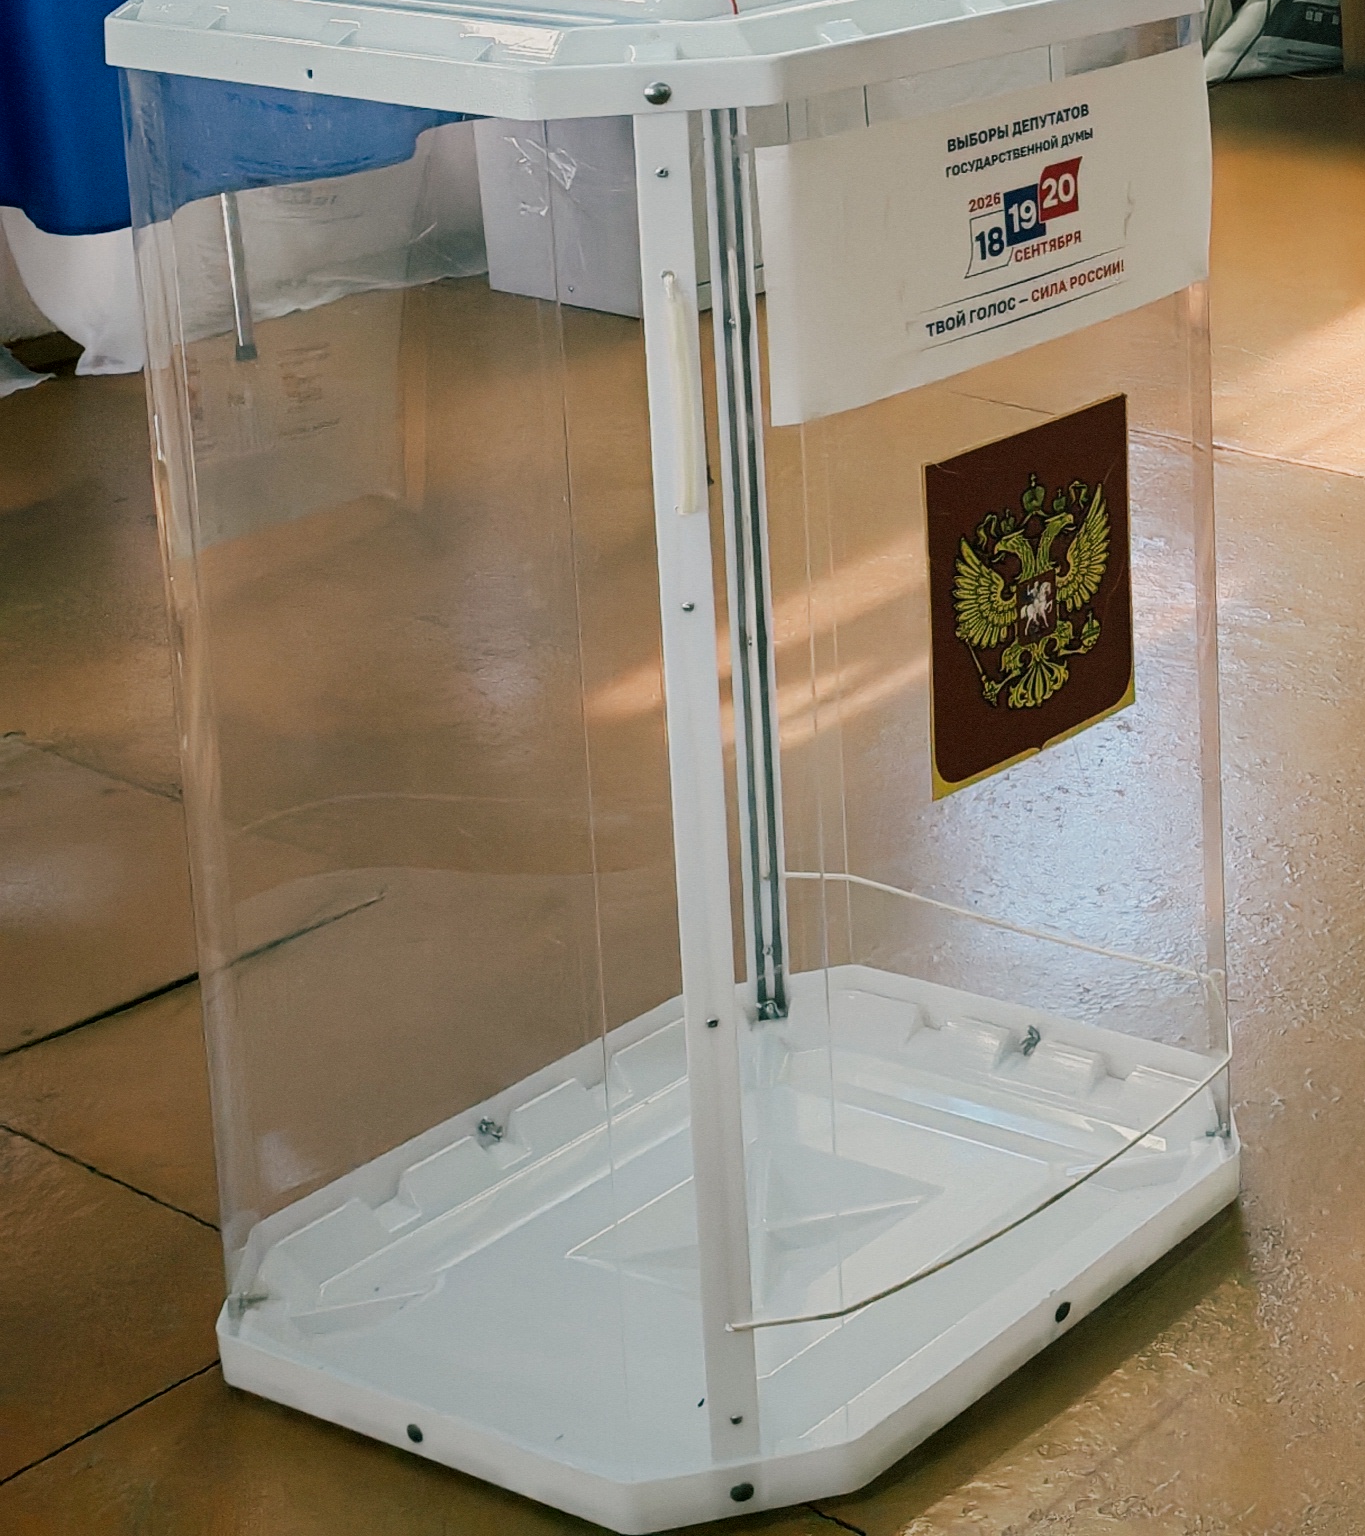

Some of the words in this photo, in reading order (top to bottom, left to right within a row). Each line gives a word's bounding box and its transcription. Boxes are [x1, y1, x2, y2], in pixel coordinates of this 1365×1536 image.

[945, 135, 1058, 178] ГОСУДАРСТВЕННОЙ
[1061, 128, 1094, 147] ДУМЫ
[947, 124, 1009, 153] ВЫБОРЫ
[1012, 104, 1089, 138] ДЕПУТАТОВ
[968, 192, 1001, 213] 2026
[974, 226, 1005, 261] 18
[1008, 199, 1036, 233] 19
[1041, 172, 1075, 209] 20
[1014, 230, 1082, 263] СЕНТЯБРЯ
[926, 311, 966, 337] ТВОЙ
[969, 297, 1016, 324] ГОЛОС
[1031, 279, 1068, 303] СИЛА
[1070, 259, 1125, 290] РОССИИ!
